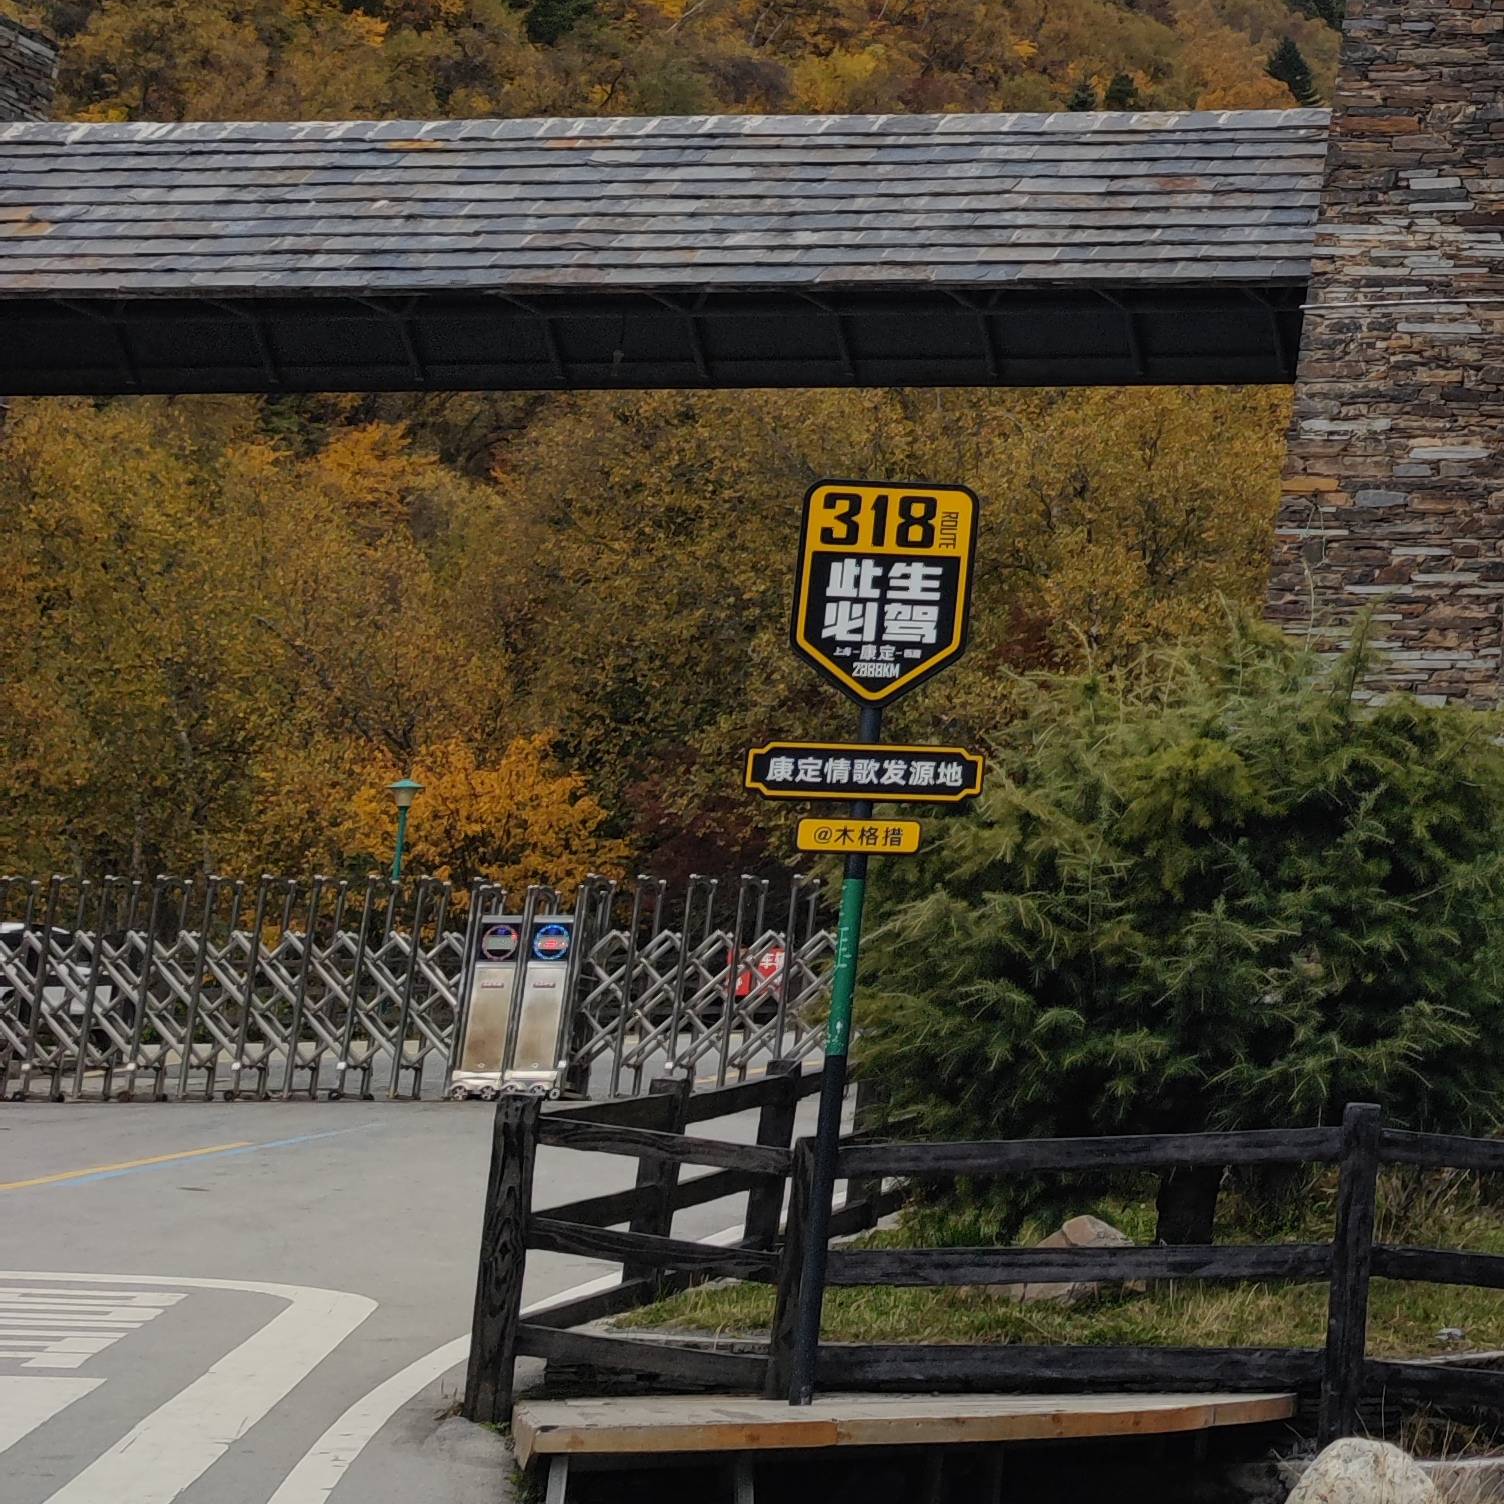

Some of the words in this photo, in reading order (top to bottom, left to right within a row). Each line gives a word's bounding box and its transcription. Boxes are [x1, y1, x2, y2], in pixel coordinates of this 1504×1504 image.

[820, 492, 937, 548] 318
[939, 510, 960, 550] ROUTE
[826, 558, 943, 601] 此生
[821, 600, 940, 644] 必驾
[766, 756, 963, 788] 康定情歌发源地
[813, 824, 903, 846] @木格措
